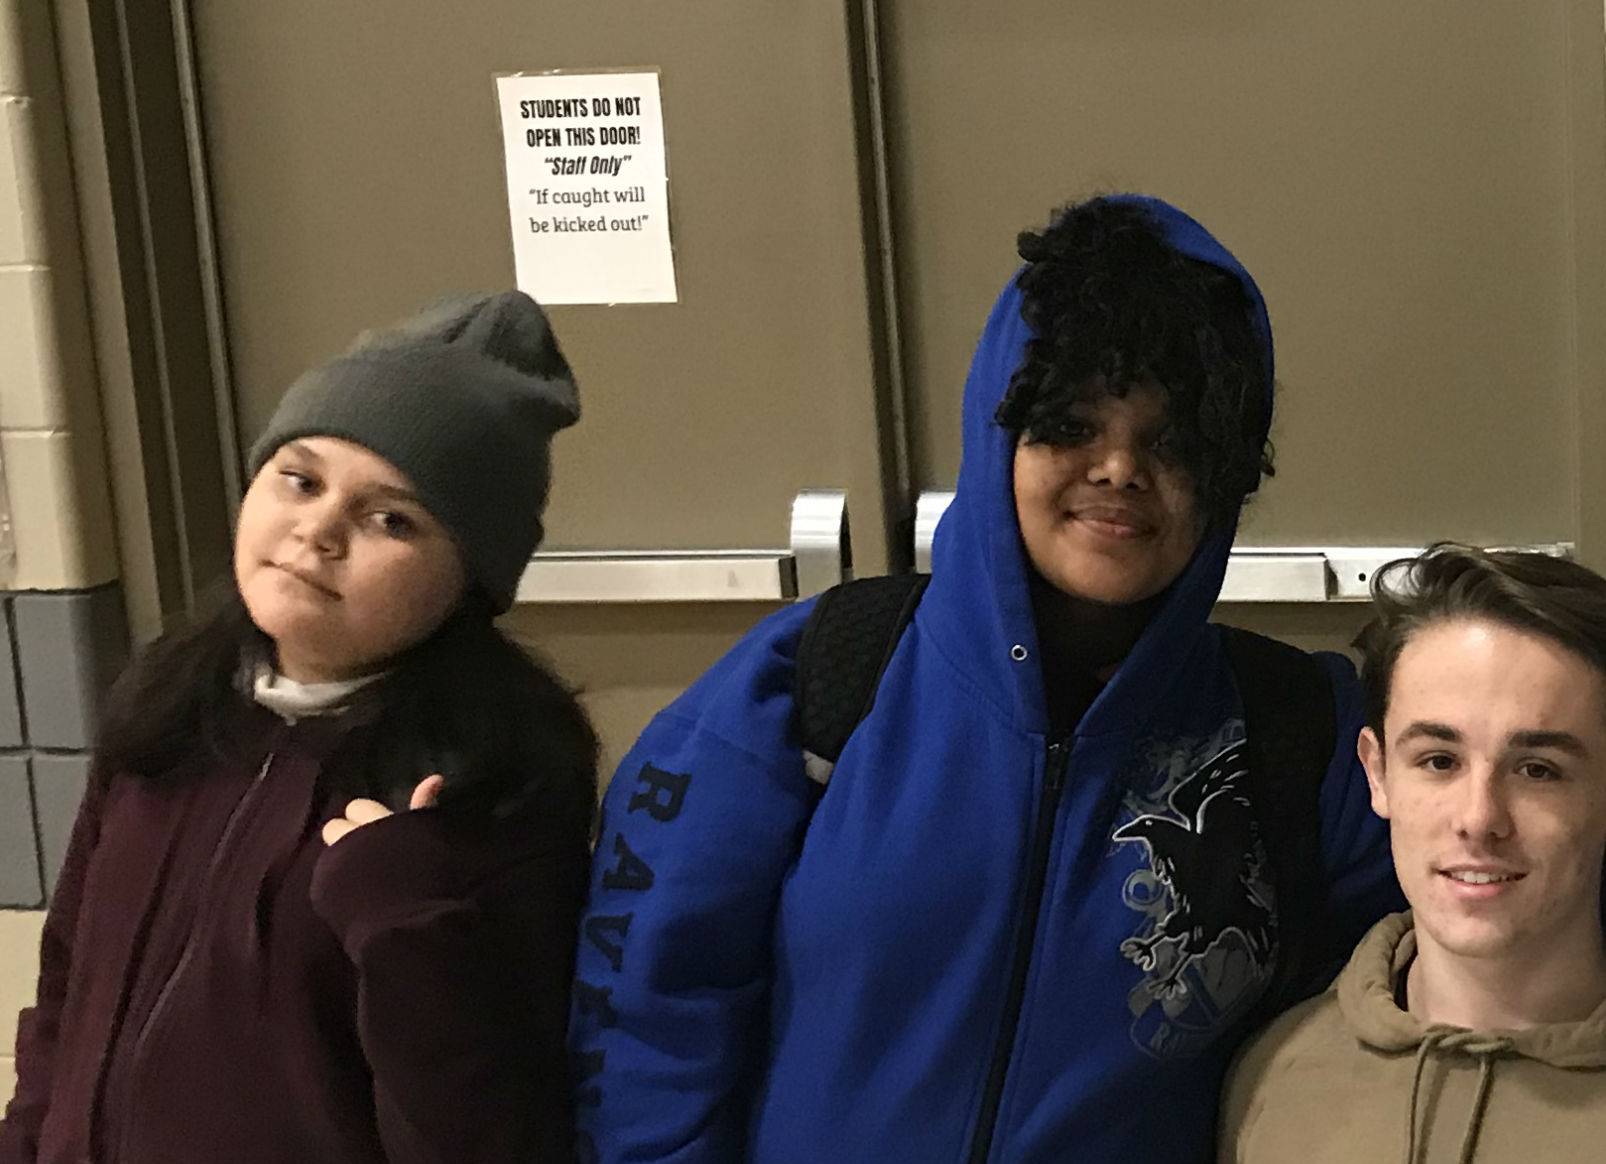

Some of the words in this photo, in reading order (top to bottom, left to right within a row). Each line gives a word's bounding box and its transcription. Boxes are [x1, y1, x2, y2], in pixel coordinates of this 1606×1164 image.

[520, 98, 588, 119] STUDENTS
[592, 97, 611, 117] DO
[616, 96, 641, 116] NOT
[526, 128, 562, 148] OPEN
[565, 127, 596, 147] THIS
[599, 126, 641, 146] DOOR!
[544, 156, 587, 176] "Staff
[590, 154, 632, 177] Only"
[552, 187, 610, 208] caught
[613, 186, 646, 203] will
[529, 217, 550, 233] be
[552, 216, 606, 233] kicked
[610, 214, 649, 232] out!"
